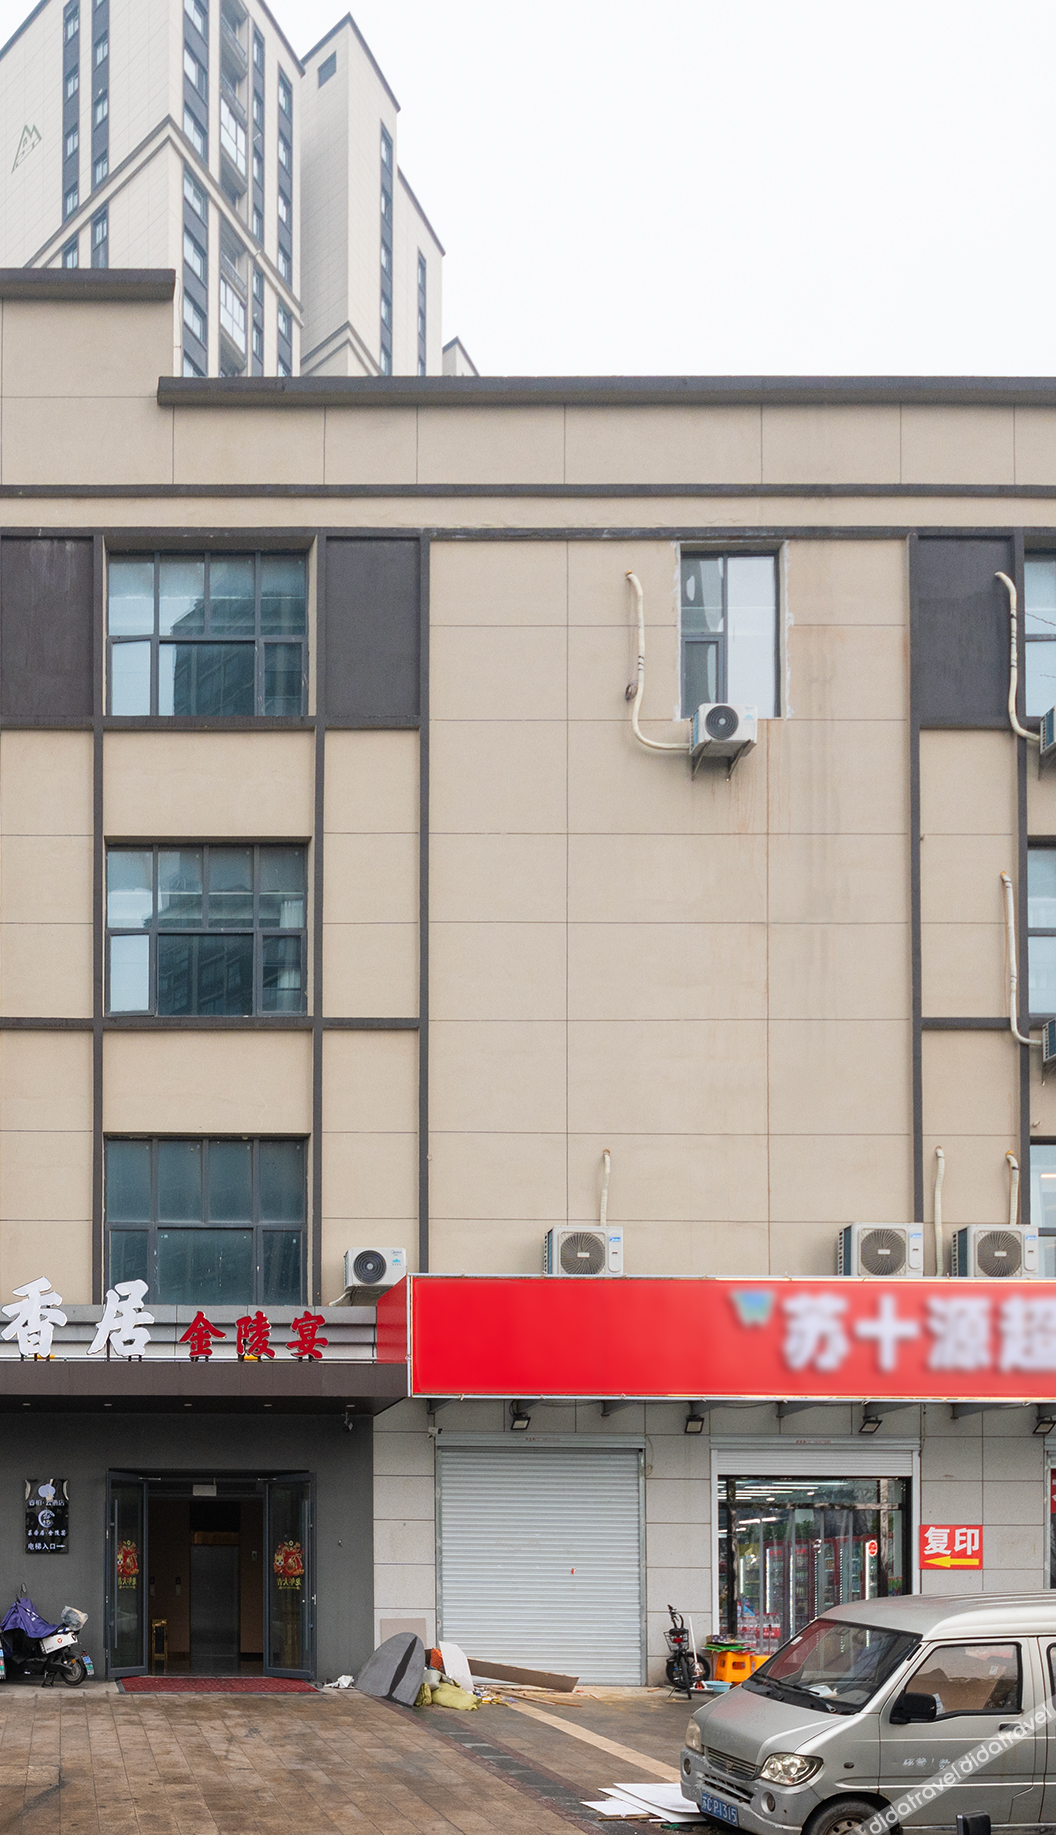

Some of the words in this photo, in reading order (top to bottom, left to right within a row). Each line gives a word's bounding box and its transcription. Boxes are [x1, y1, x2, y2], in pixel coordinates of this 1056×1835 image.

[178, 1310, 330, 1360] 金陵宴
[923, 1526, 980, 1555] 复印
